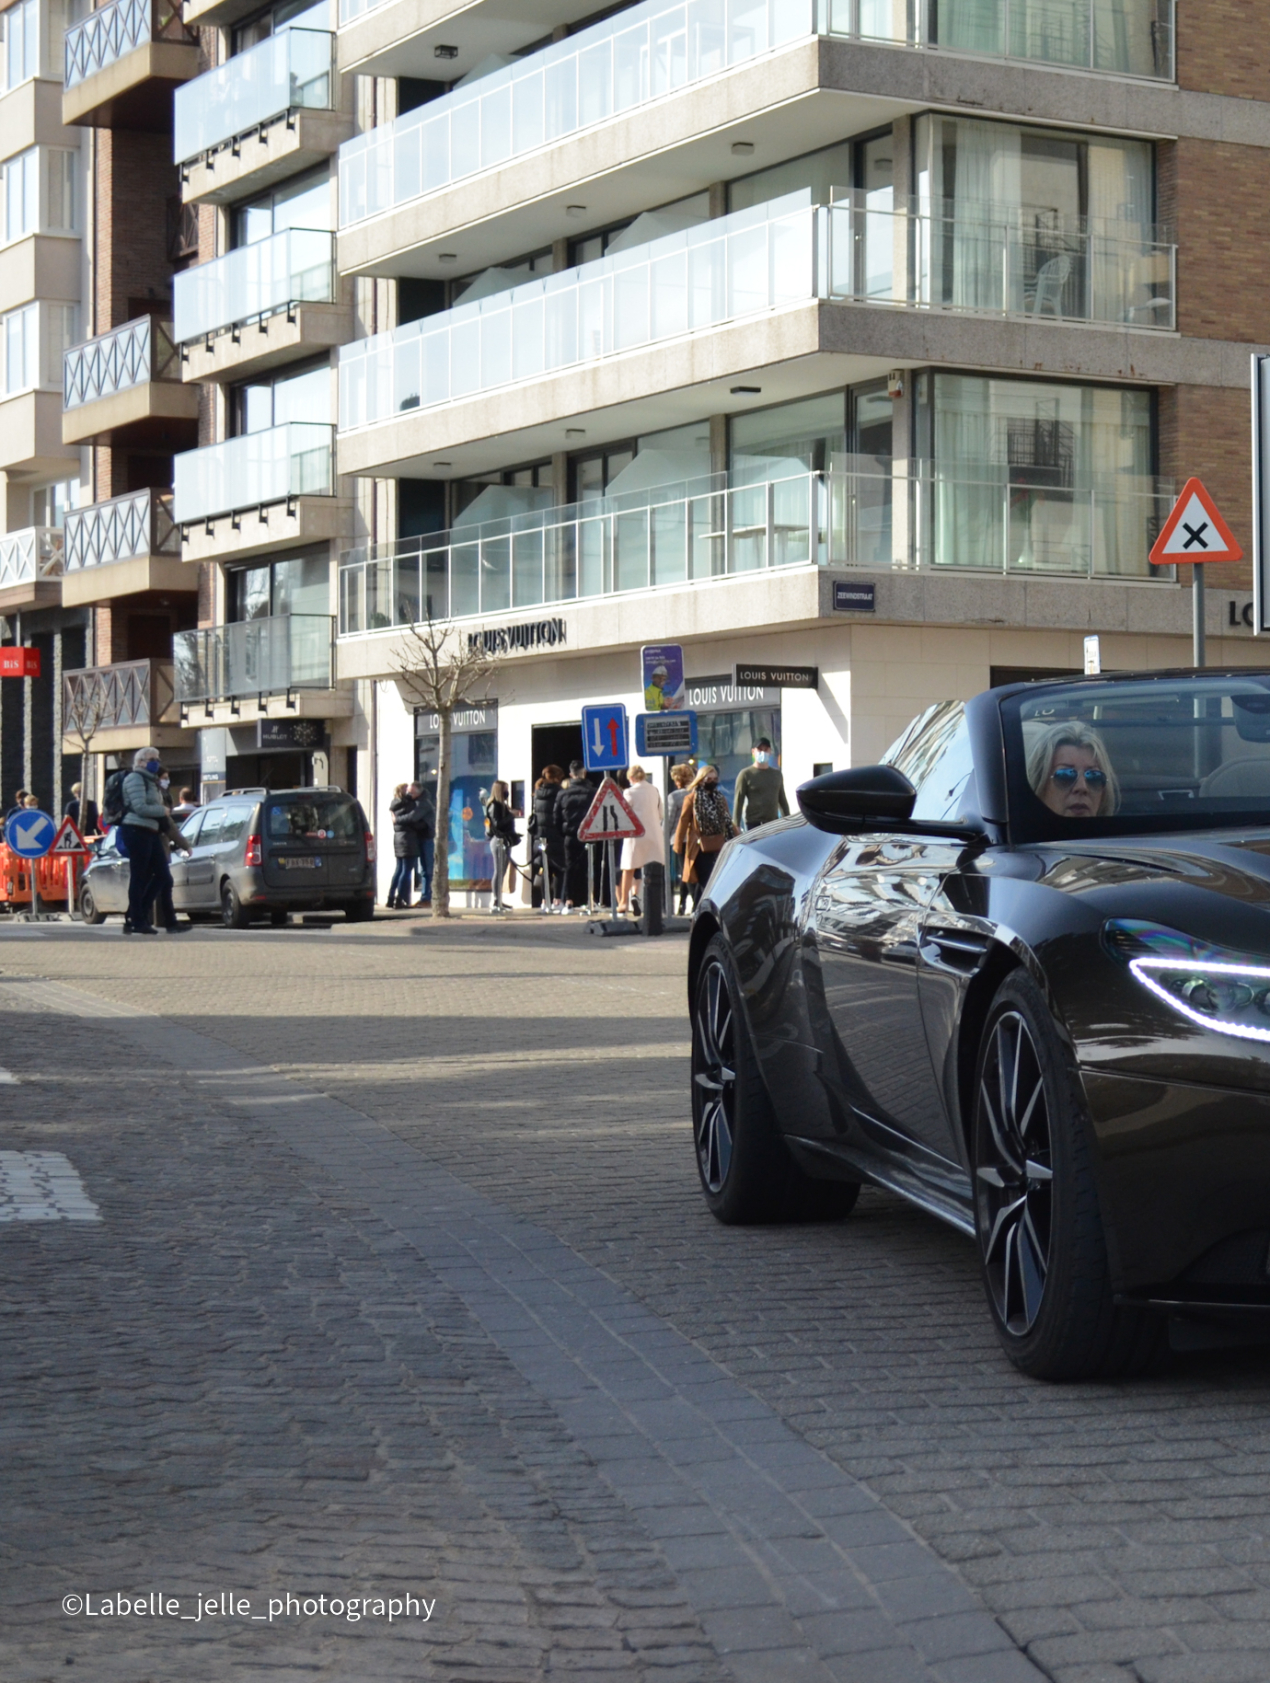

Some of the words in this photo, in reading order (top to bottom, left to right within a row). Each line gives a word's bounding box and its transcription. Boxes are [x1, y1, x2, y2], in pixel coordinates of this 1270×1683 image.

[506, 617, 567, 652] VUITTON
[740, 671, 767, 680] LOUIS
[770, 672, 809, 681] VUITTON
[689, 687, 717, 706] LOUIS
[720, 684, 764, 702] VUITTON
[453, 709, 486, 727] VUITTON
